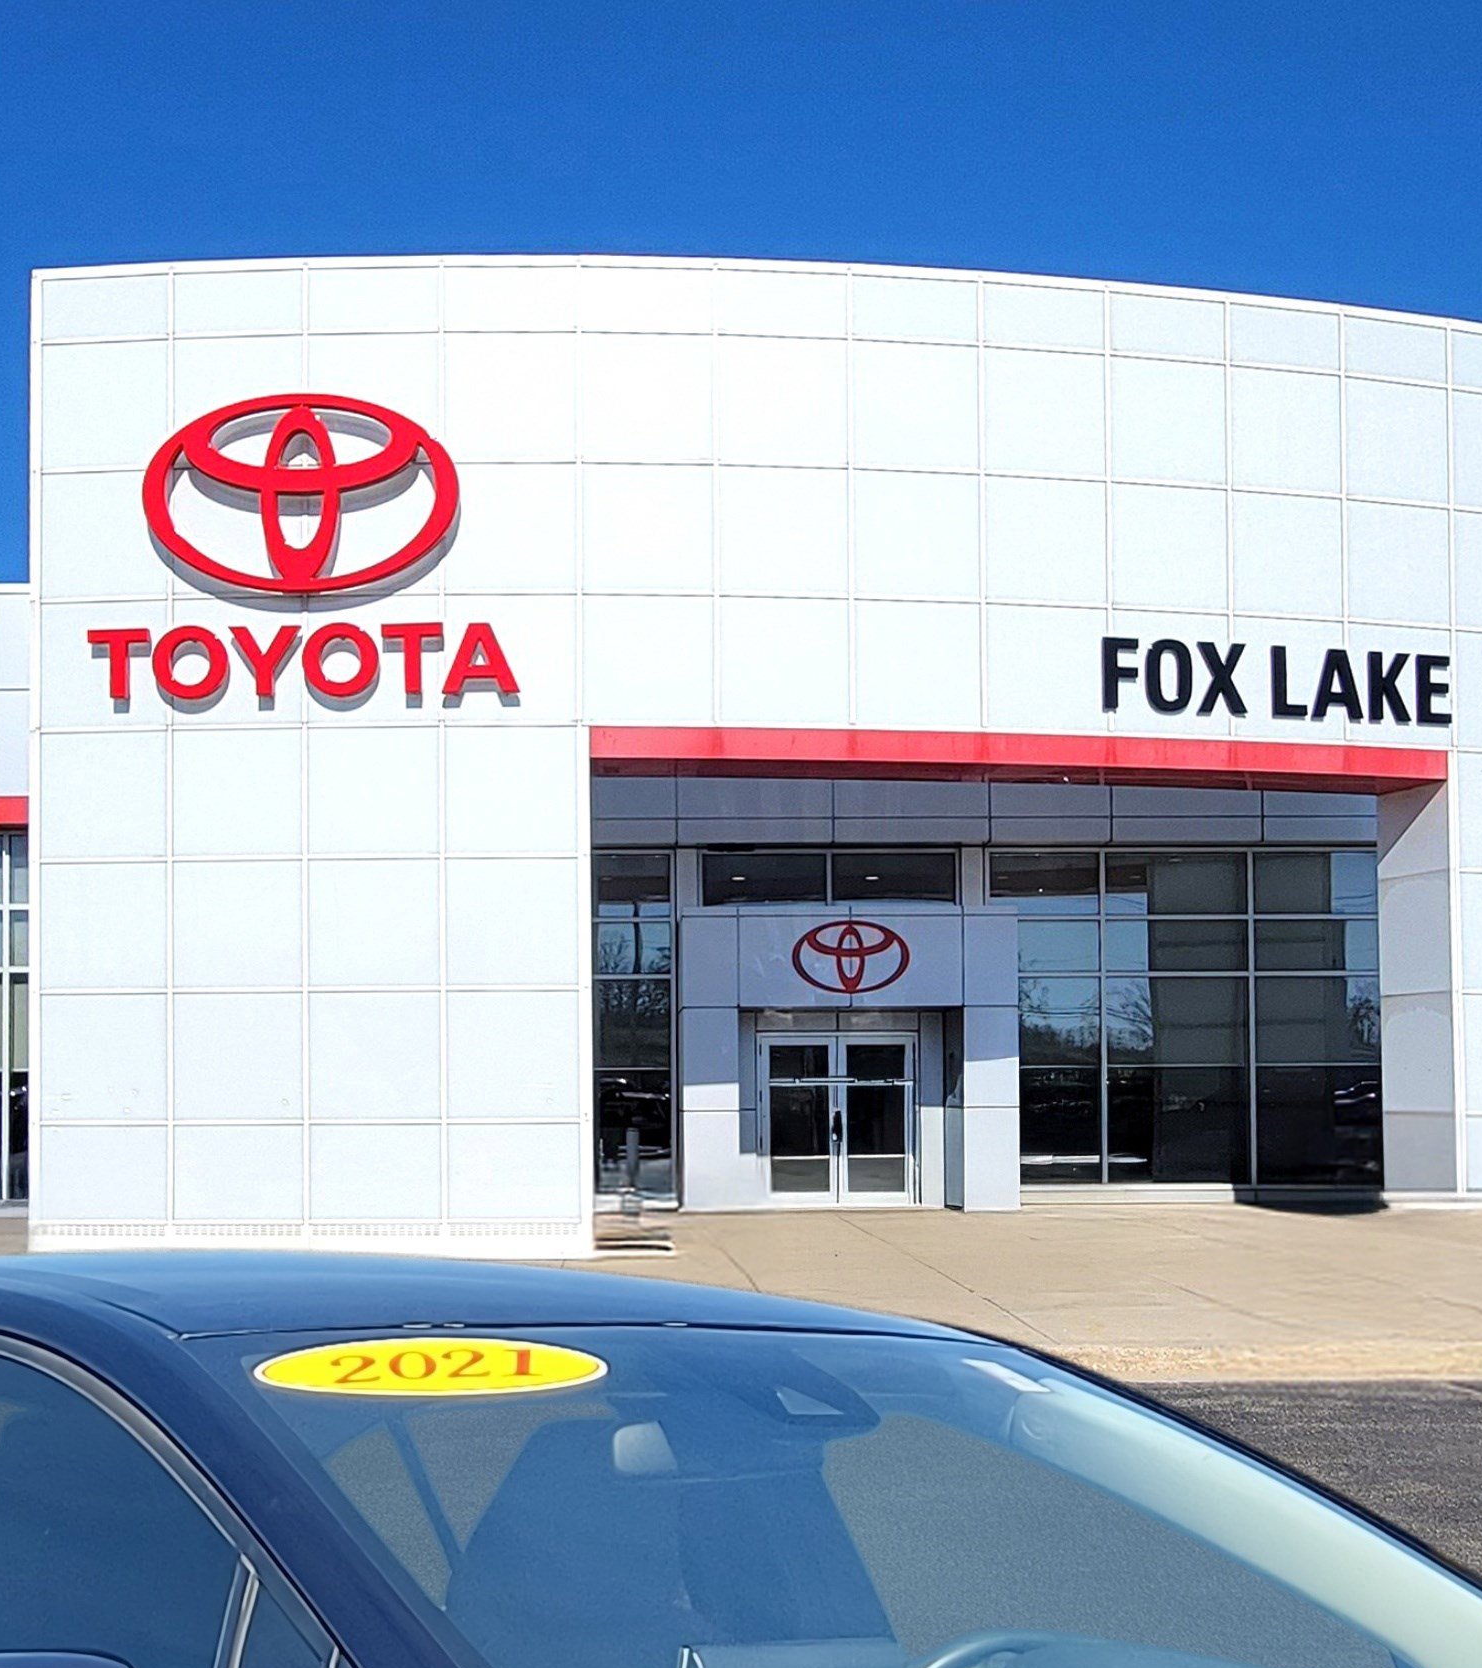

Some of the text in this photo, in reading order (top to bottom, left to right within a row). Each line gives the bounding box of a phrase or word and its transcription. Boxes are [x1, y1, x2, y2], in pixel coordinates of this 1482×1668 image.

[87, 622, 521, 703] TOYOTA
[1103, 636, 1453, 725] FOX LAKE
[329, 1348, 544, 1384] 2021
